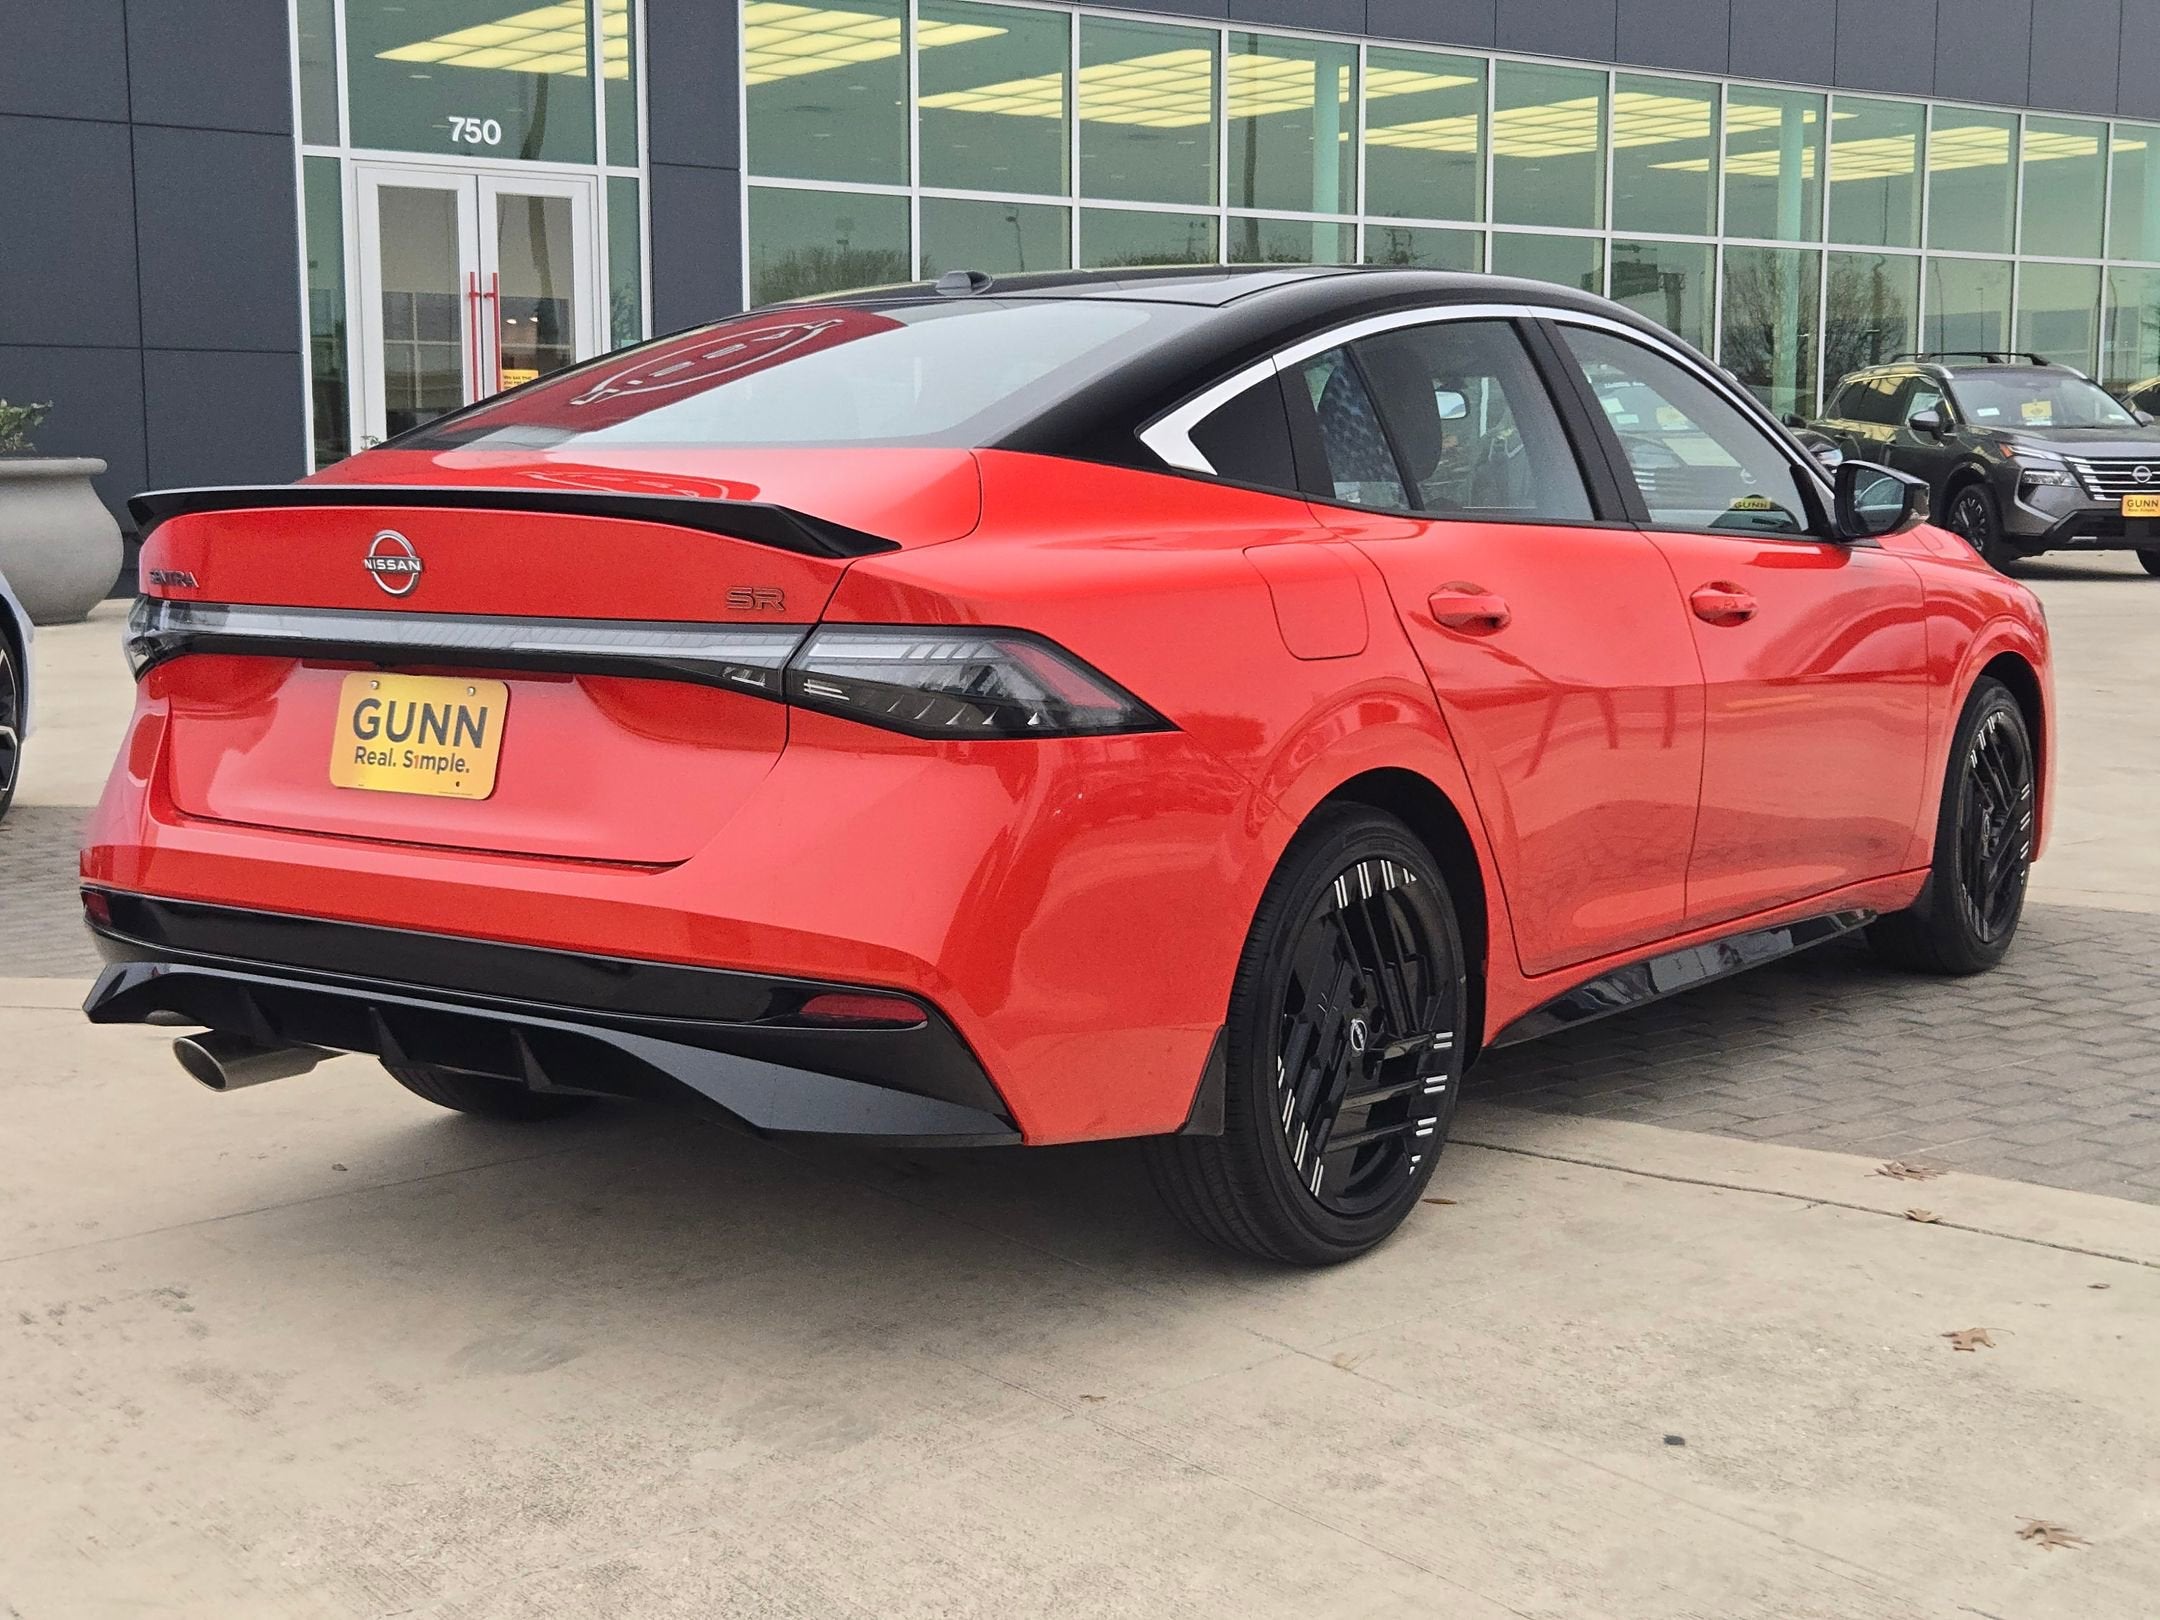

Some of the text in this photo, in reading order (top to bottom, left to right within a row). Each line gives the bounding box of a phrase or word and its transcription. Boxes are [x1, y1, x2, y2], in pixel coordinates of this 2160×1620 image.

[448, 116, 502, 146] 750
[2126, 499, 2159, 508] GUNN
[364, 558, 421, 571] NISSAN
[726, 586, 785, 611] SR
[353, 698, 488, 749] GUNN
[354, 746, 397, 768] Real.
